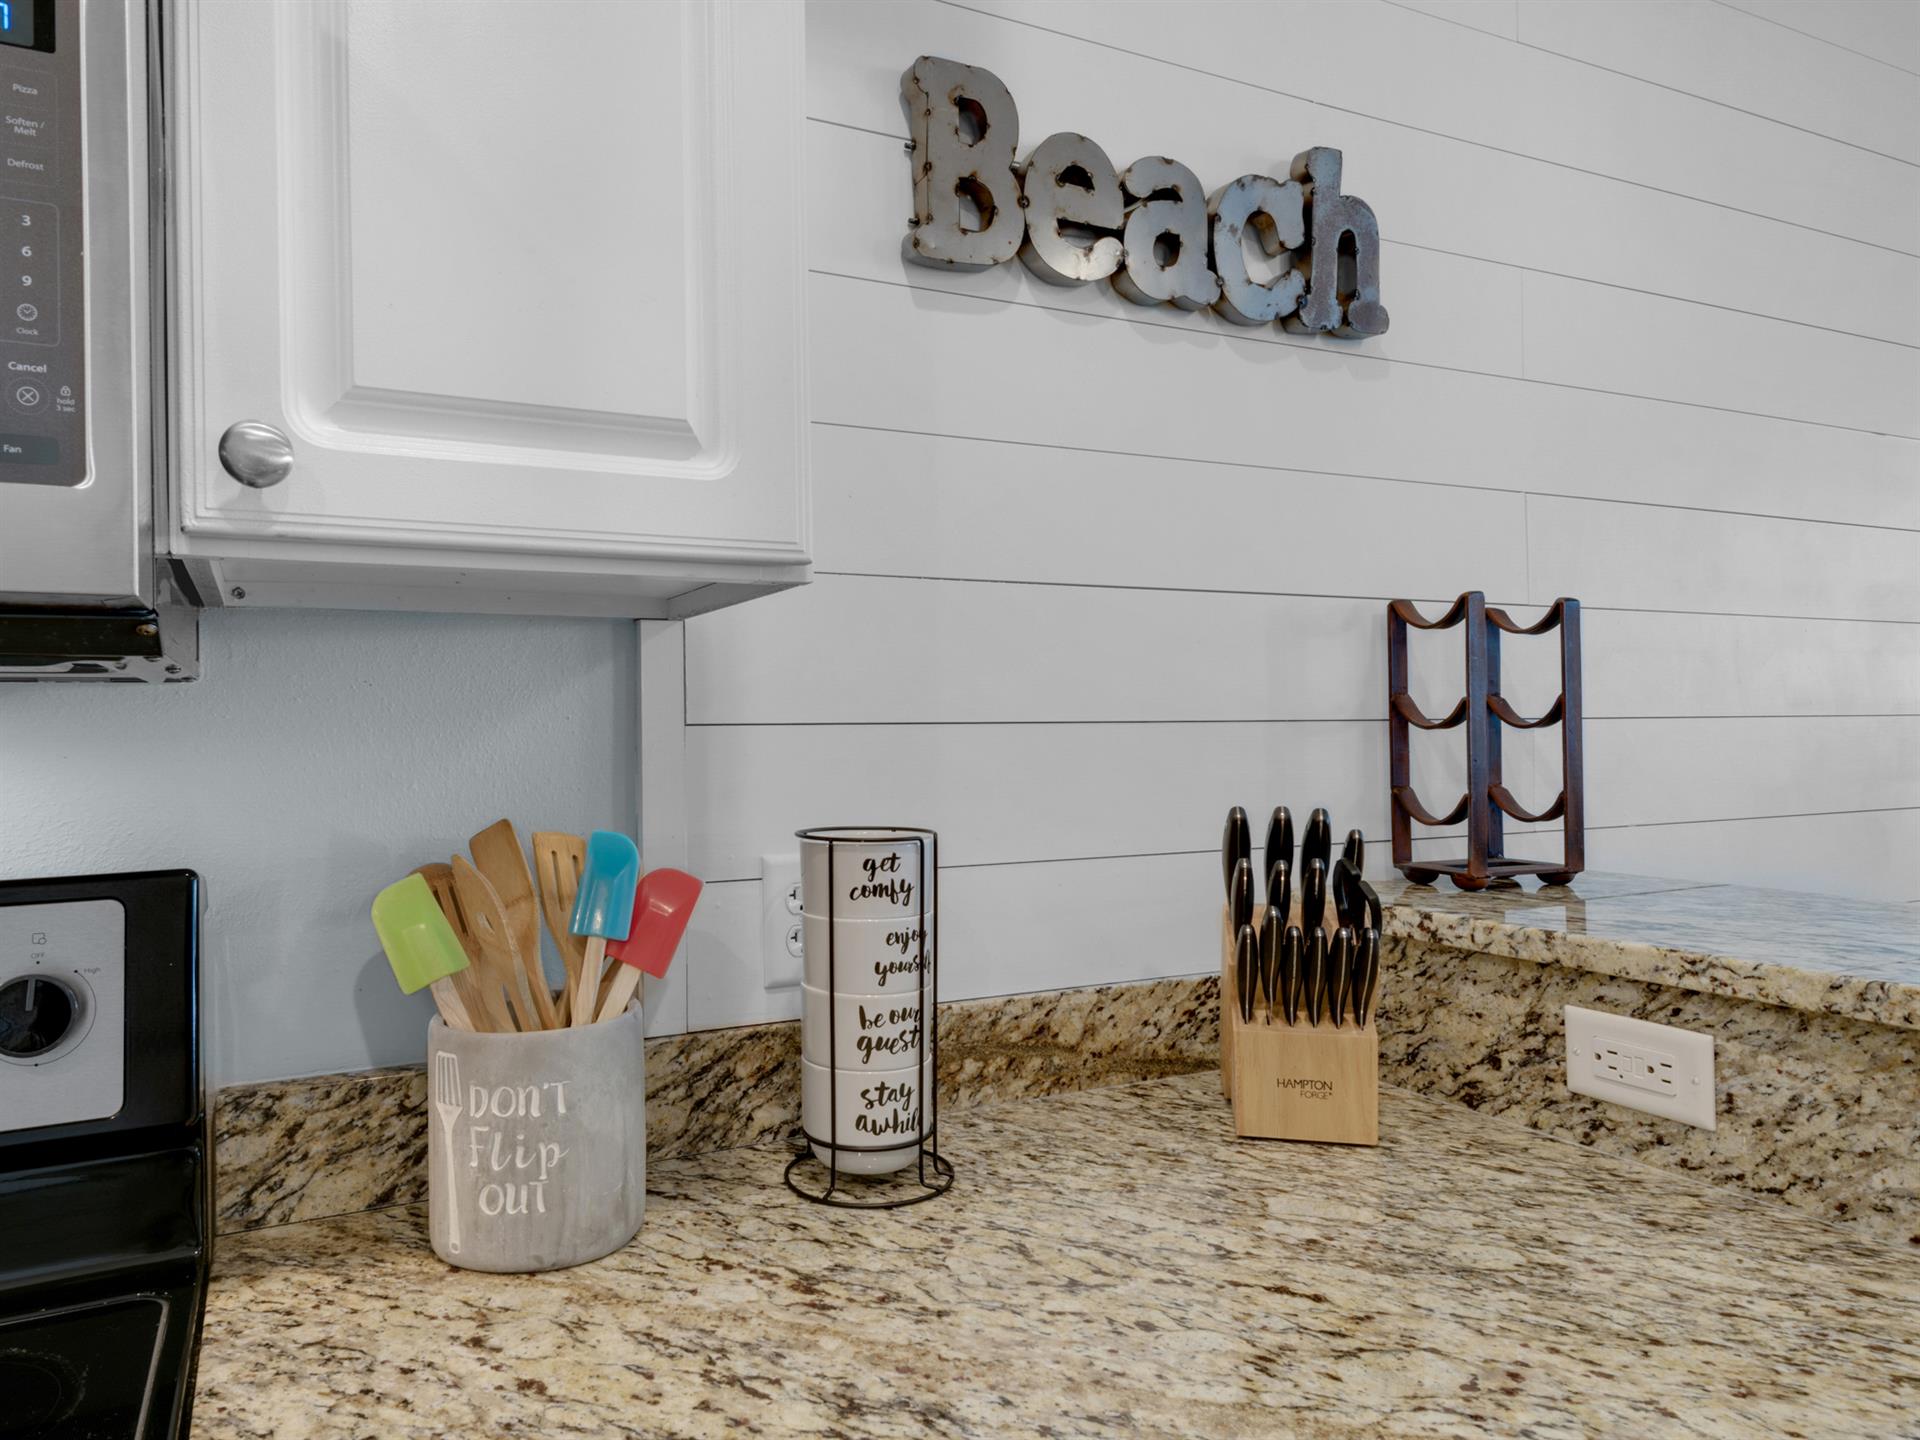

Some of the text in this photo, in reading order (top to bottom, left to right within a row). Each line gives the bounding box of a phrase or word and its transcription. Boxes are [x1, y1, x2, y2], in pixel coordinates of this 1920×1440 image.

[12, 83, 38, 96] Pizza
[5, 115, 39, 129] Soften
[13, 126, 37, 137] Melt
[7, 158, 44, 171] Defrost
[901, 55, 1389, 340] Beach
[21, 215, 32, 226] 3
[21, 246, 32, 257] 6
[21, 275, 32, 286] 9
[16, 327, 39, 336] Clock
[8, 361, 47, 373] Cancel
[56, 398, 76, 406] hold
[3, 444, 22, 453] Fan
[863, 853, 901, 882] get
[850, 878, 914, 906] comfy
[874, 949, 931, 987] yourslf
[858, 1005, 886, 1030] be
[857, 1025, 921, 1064] guest
[1276, 1078, 1333, 1091] HAMPTON
[860, 1081, 915, 1111] stay
[1300, 1091, 1328, 1100] FORGE
[855, 1108, 921, 1136] awhil
